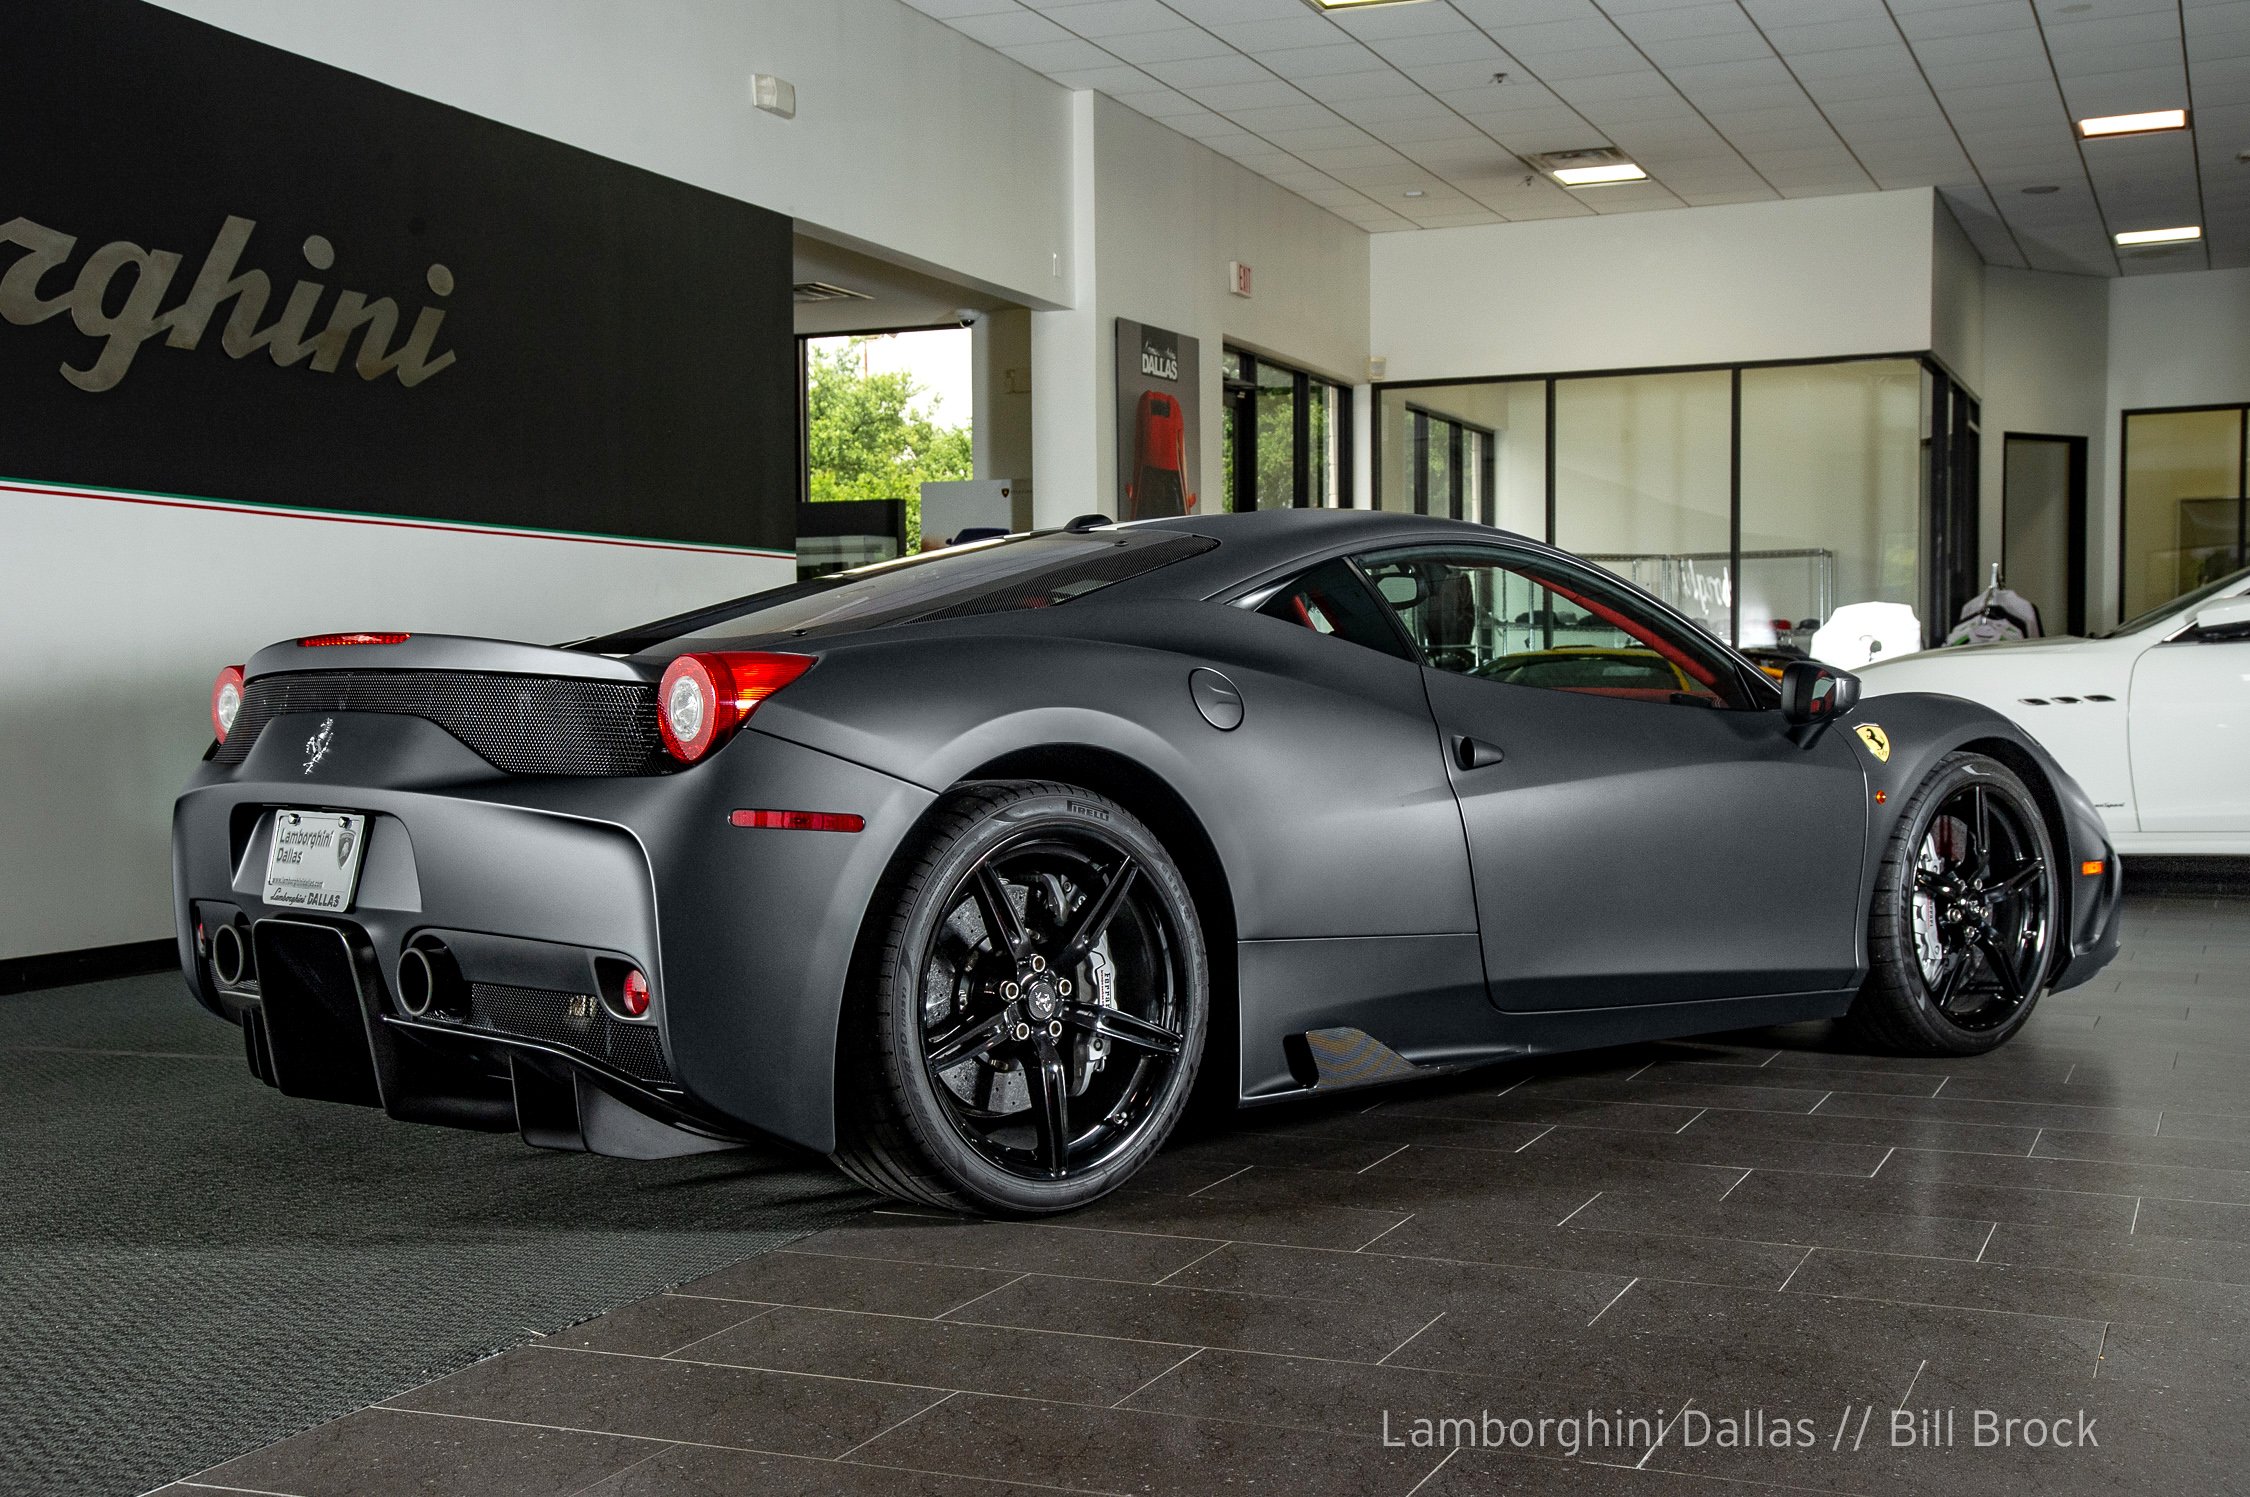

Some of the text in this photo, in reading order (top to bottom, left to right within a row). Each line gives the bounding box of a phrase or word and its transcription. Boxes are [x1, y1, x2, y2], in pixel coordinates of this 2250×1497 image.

[1142, 353, 1178, 380] DALLAS
[1066, 800, 1109, 821] PIRELLI
[279, 828, 334, 849] Lamborghini
[276, 847, 303, 864] Dallas
[270, 887, 340, 908] Lamborghini DALLAS
